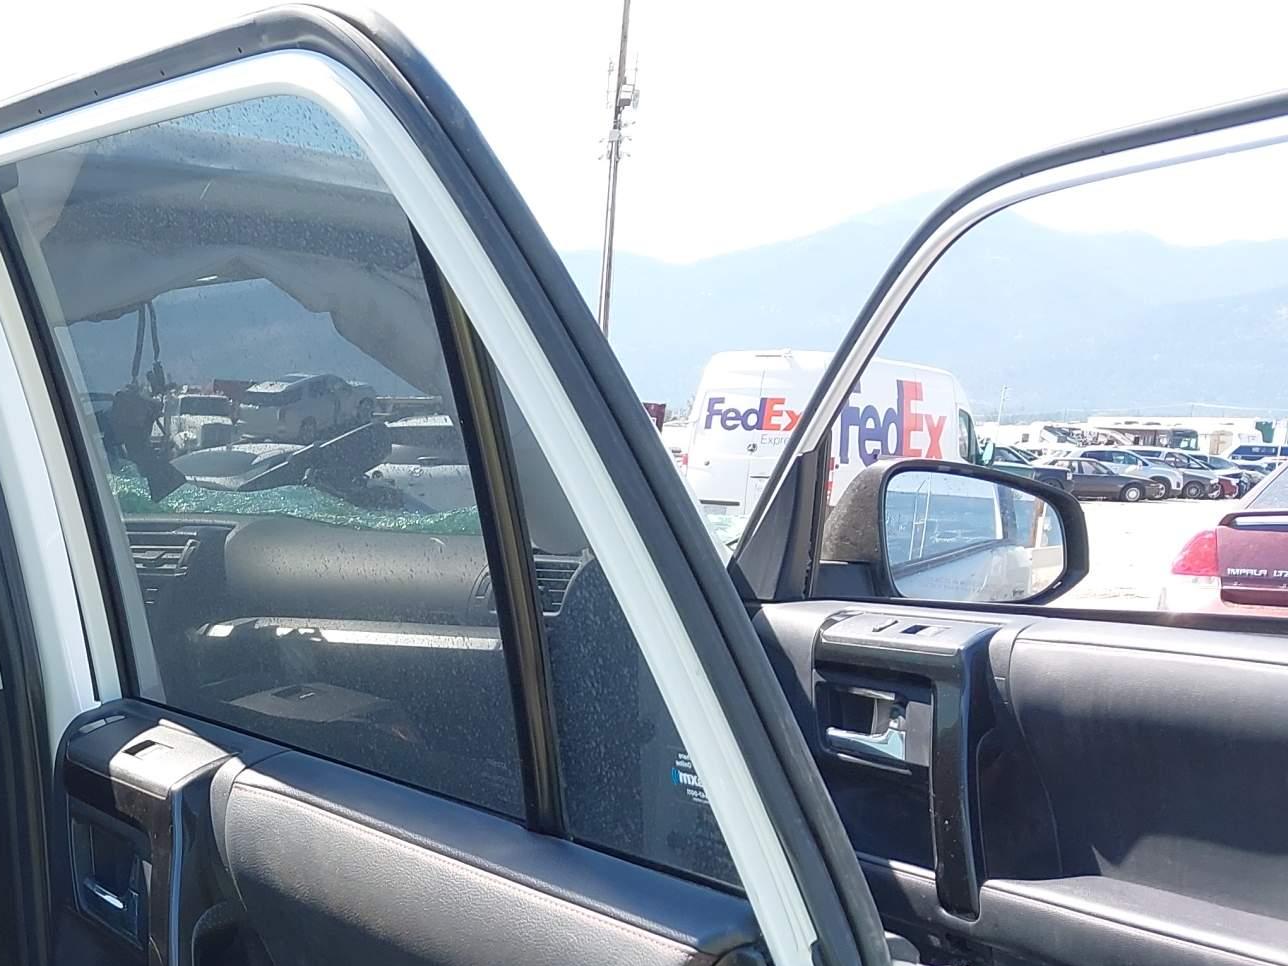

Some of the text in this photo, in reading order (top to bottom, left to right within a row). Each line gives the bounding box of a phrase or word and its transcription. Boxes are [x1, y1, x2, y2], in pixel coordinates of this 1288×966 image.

[704, 397, 801, 431] FedEx
[839, 379, 947, 467] FedEx
[760, 434, 790, 446] Expr
[1227, 568, 1268, 576] IMPALA
